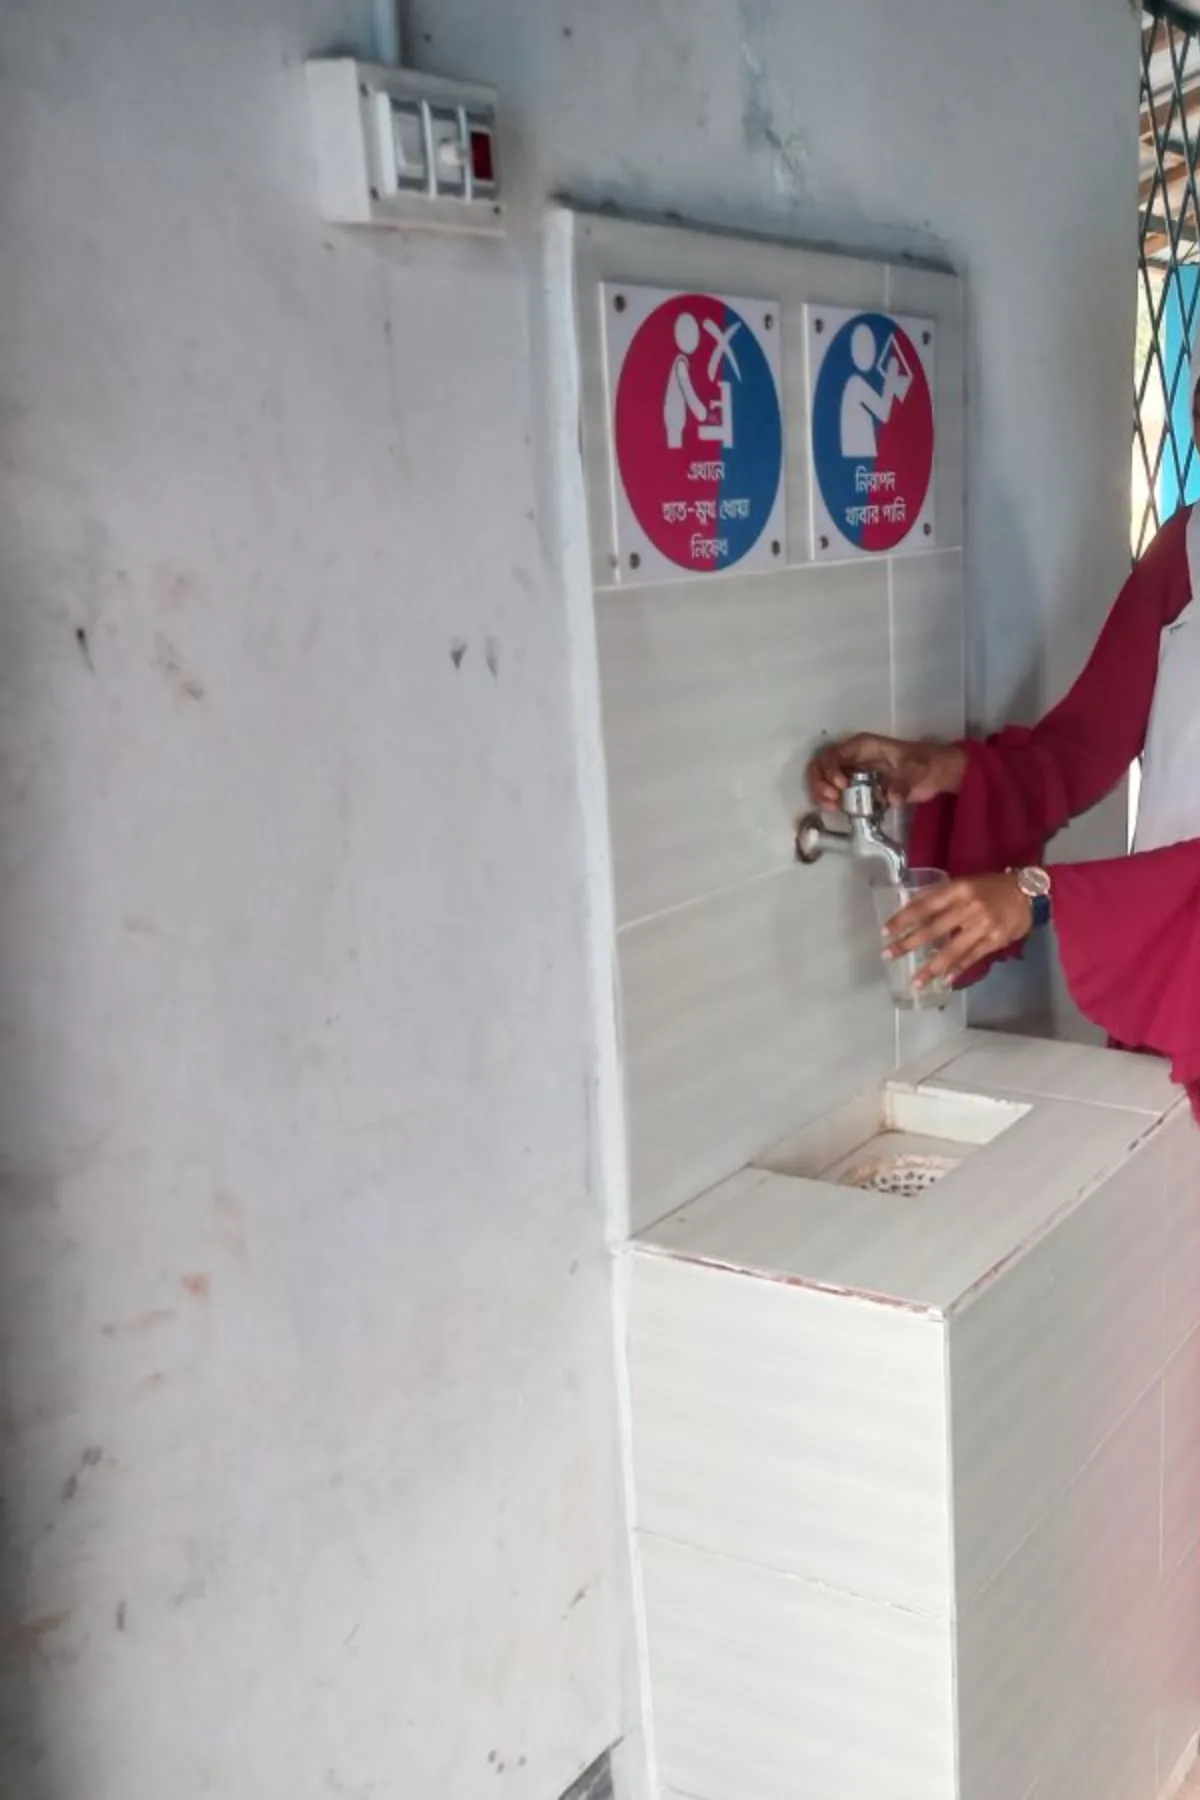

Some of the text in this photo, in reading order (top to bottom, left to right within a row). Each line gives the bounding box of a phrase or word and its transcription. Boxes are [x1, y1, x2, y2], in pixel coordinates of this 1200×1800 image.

[687, 461, 725, 481] এখানে
[855, 465, 896, 493] নিরাপদ
[661, 500, 717, 525] হাত-মুখ
[845, 496, 907, 527] খাবার পানি
[690, 533, 729, 560] নিষেধ
